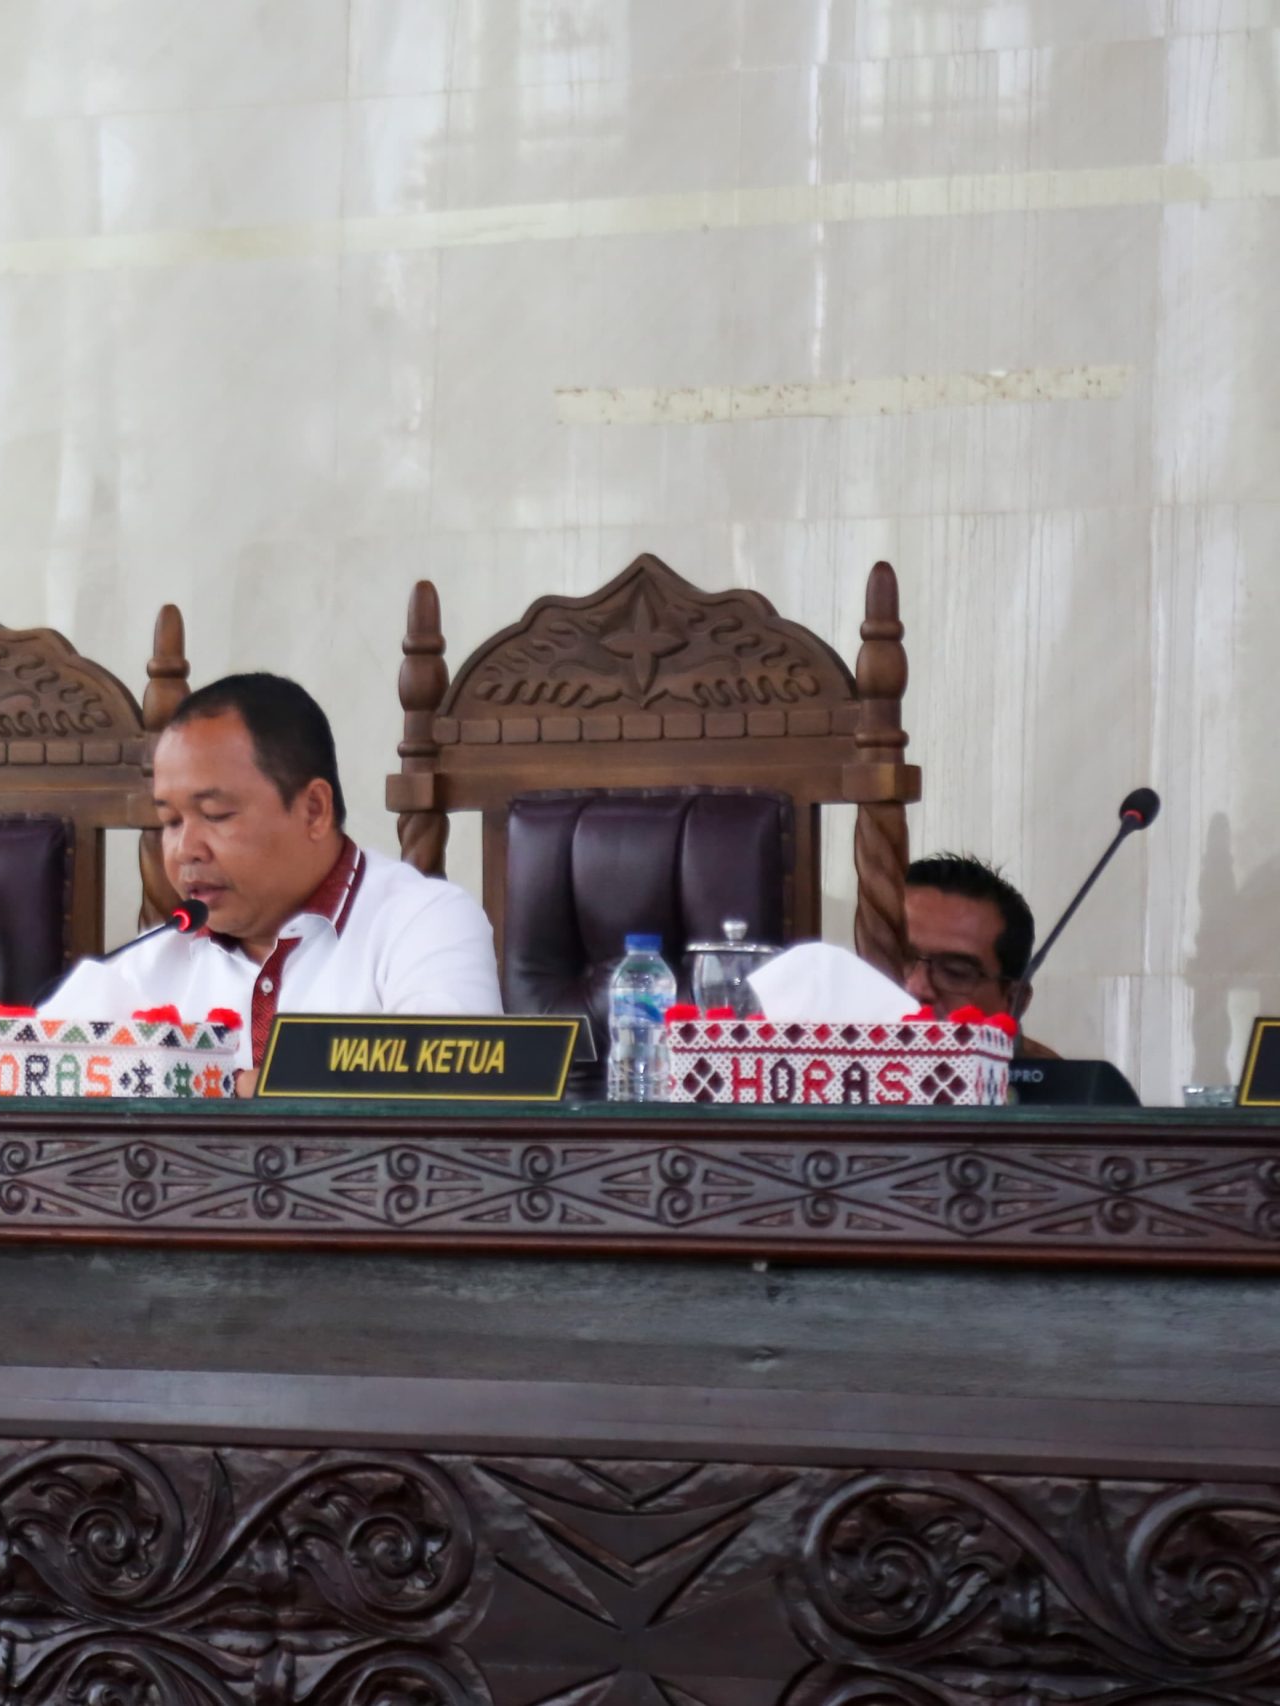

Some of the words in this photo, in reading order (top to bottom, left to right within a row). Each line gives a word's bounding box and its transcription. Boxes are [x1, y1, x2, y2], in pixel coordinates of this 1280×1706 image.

[329, 1038, 409, 1072] WAKIL
[416, 1039, 506, 1074] KETUA
[730, 1056, 913, 1104] HORAS
